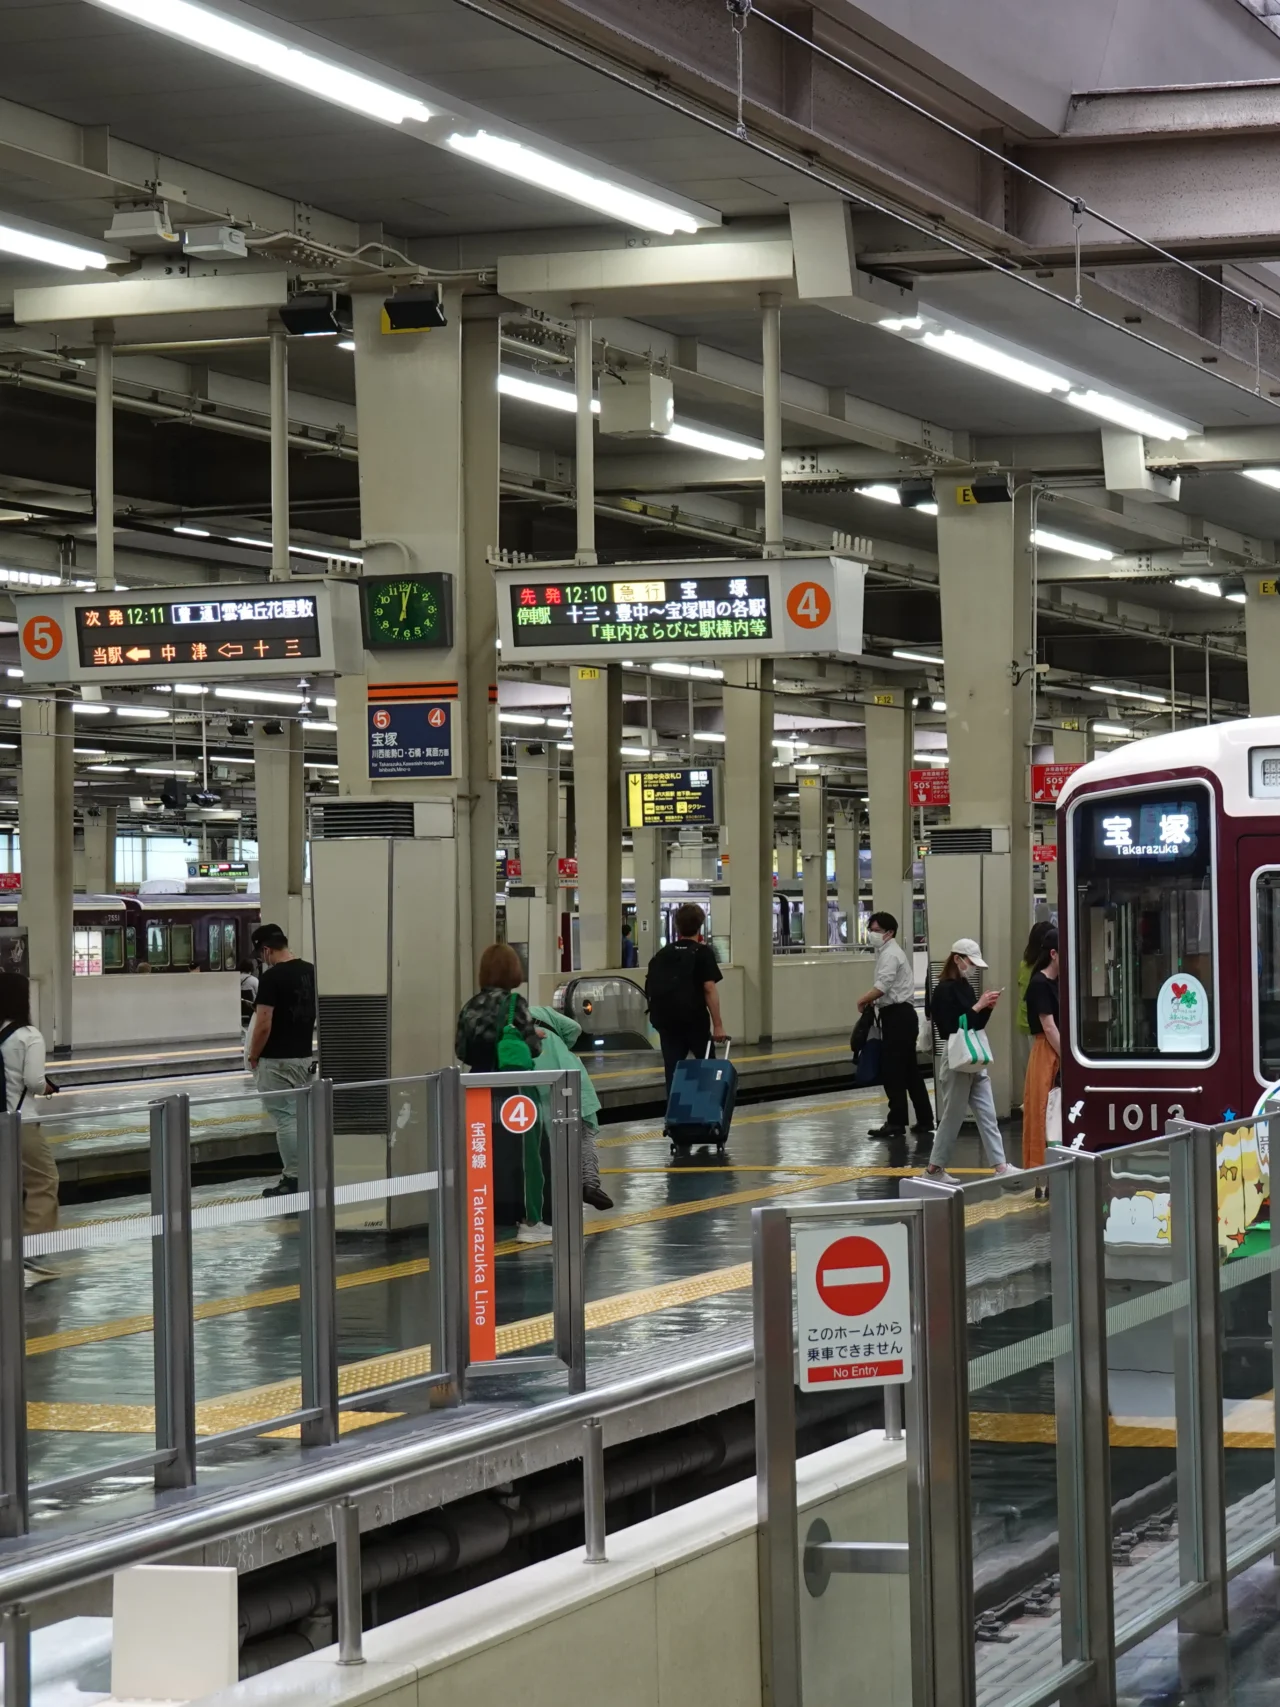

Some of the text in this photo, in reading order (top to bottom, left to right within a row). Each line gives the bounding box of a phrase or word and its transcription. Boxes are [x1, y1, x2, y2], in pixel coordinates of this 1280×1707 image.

[388, 587, 398, 595] 11
[399, 584, 409, 592] 12
[520, 578, 749, 605] 先発 12:10 急行 宝塚
[380, 596, 390, 604] 10
[422, 593, 429, 601] 2
[796, 587, 820, 622] 4
[85, 609, 124, 627] 次発
[127, 606, 165, 625] 12:11
[376, 608, 383, 616] 9
[427, 605, 434, 613] 3
[517, 607, 551, 626] 停車駅
[382, 620, 389, 628] 8
[414, 627, 421, 635] 5
[33, 622, 54, 655] 5
[93, 639, 302, 666] 当駅 中津 十三
[376, 711, 387, 728] 5
[431, 709, 442, 726] 4
[371, 732, 398, 747] 宝塚
[1046, 777, 1064, 785] SOS
[1103, 814, 1191, 846] 宝塚
[1116, 844, 1179, 855] Takarazuka
[508, 1101, 529, 1127] 4
[471, 1121, 487, 1169] 宝塚線
[473, 1184, 489, 1326] Takarazuka Line
[807, 1321, 903, 1342] このホームから
[807, 1341, 904, 1362] 乗車できません
[833, 1365, 879, 1378] No Entry
